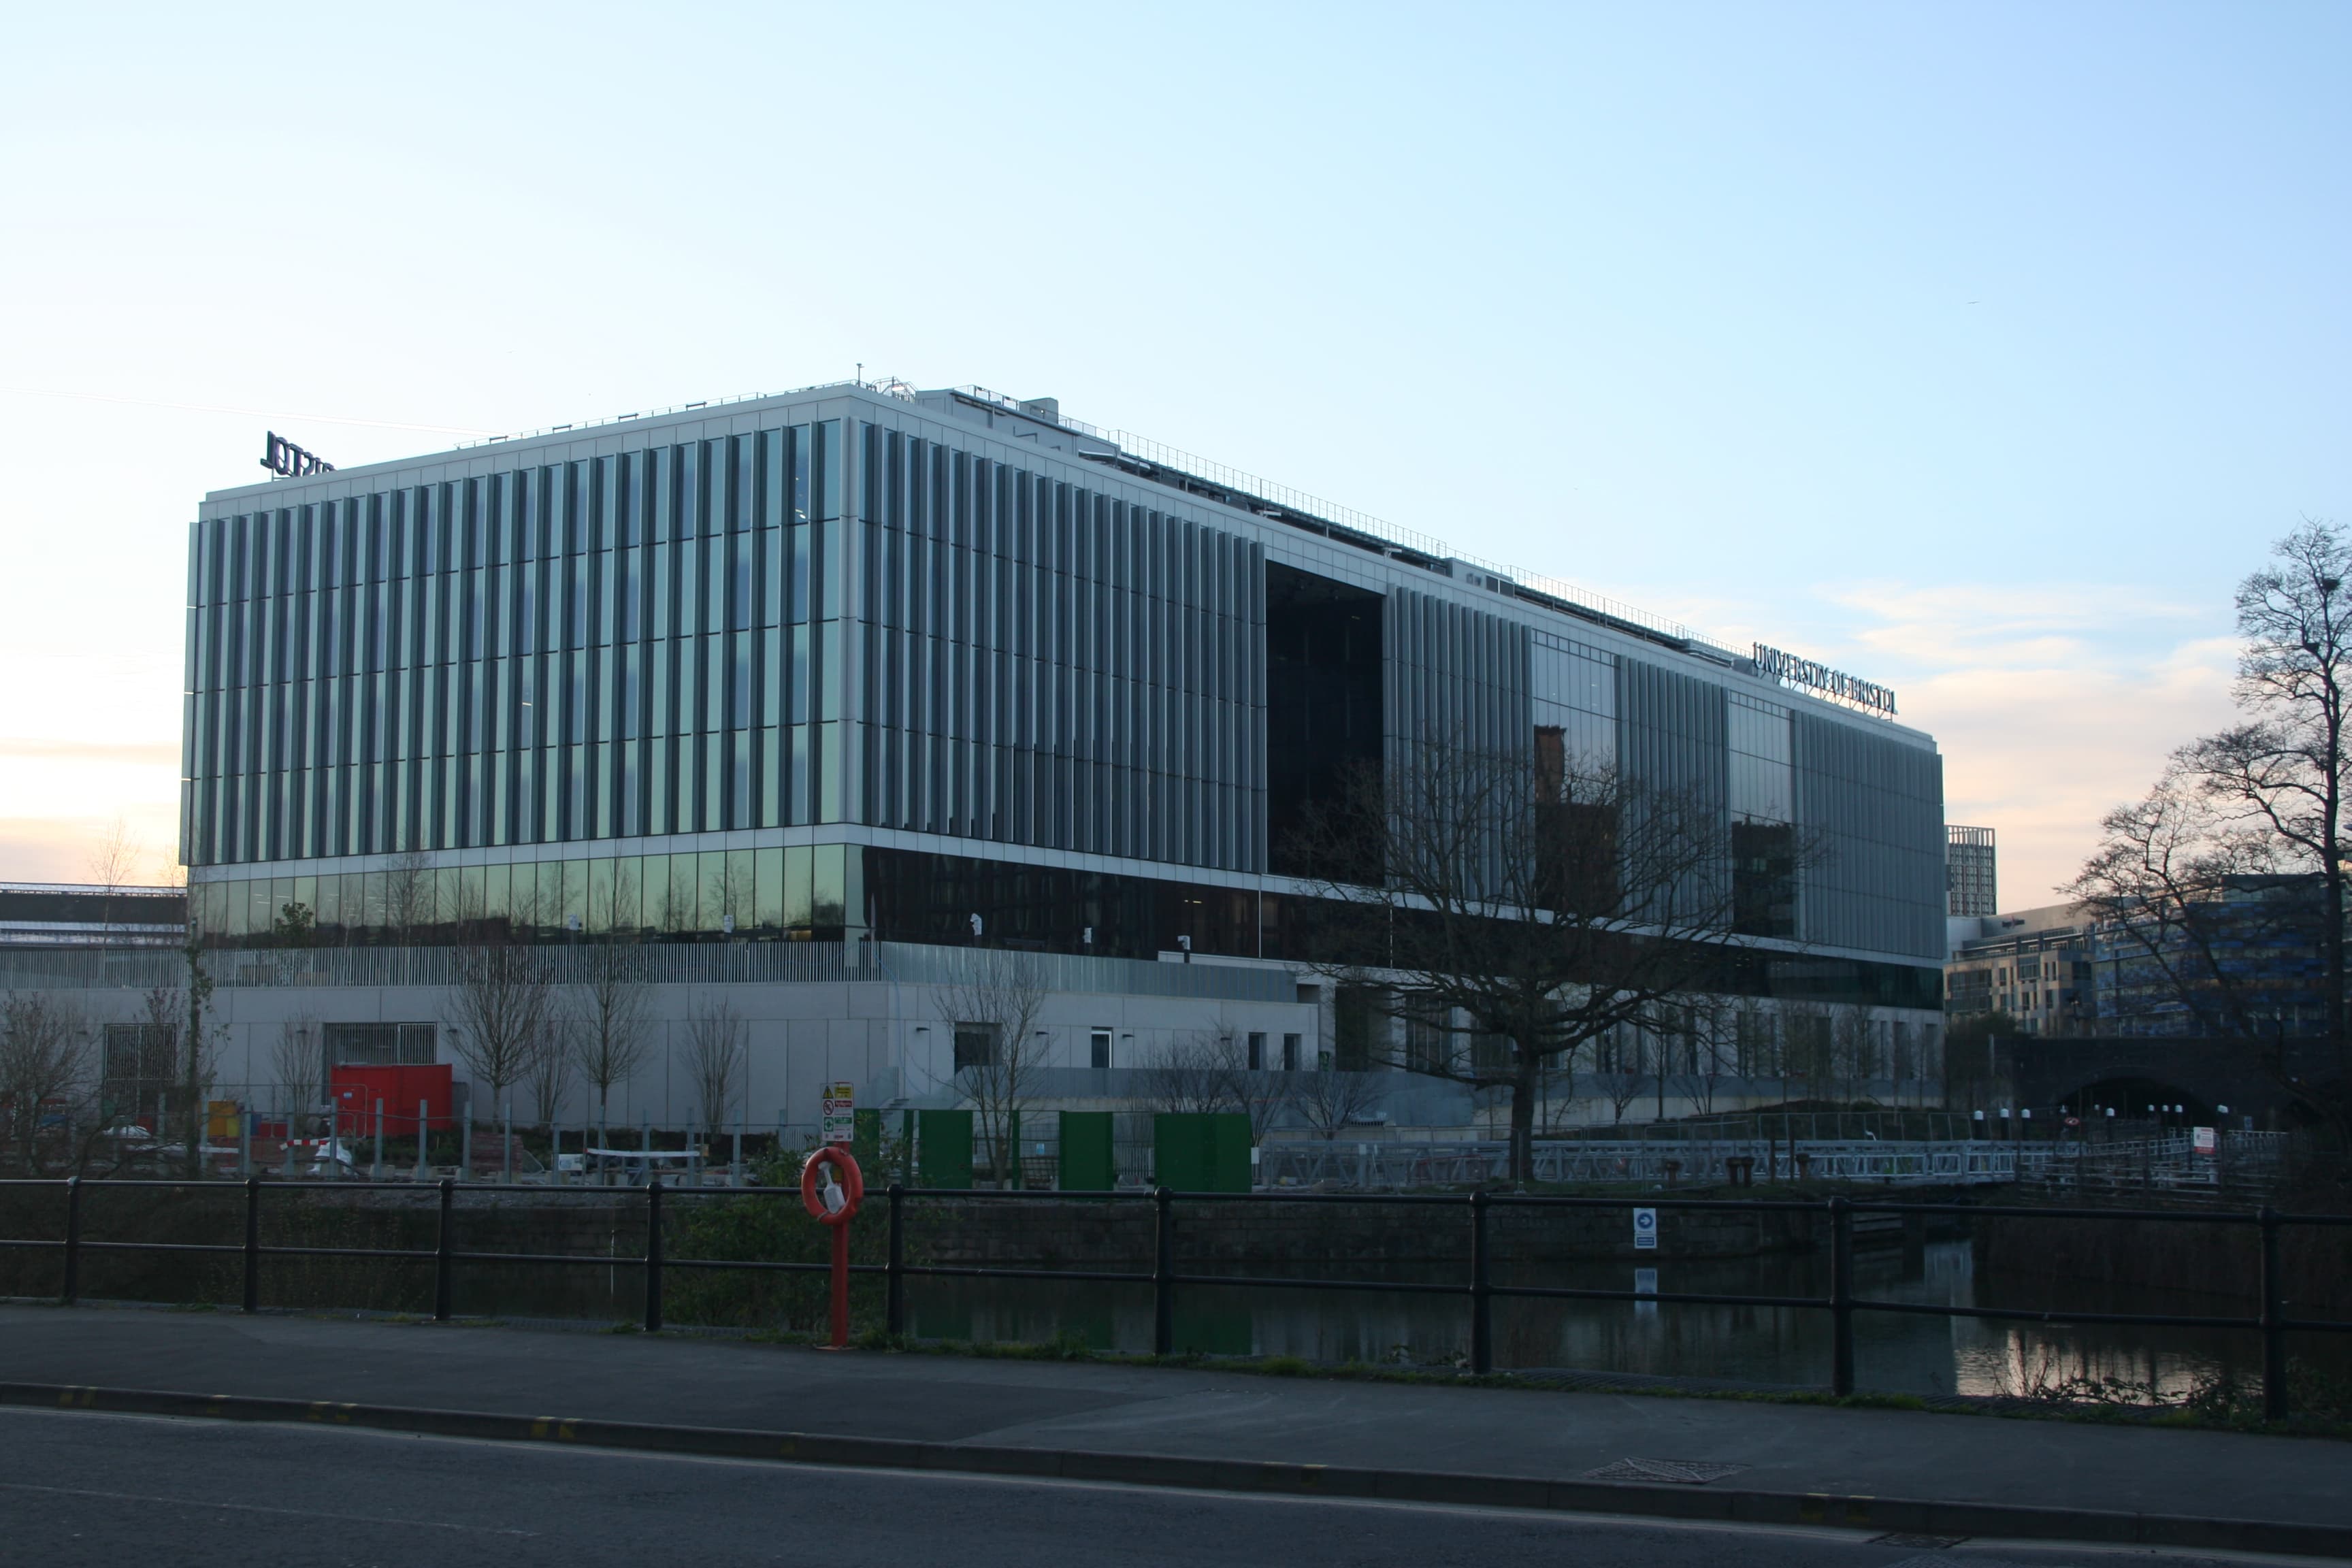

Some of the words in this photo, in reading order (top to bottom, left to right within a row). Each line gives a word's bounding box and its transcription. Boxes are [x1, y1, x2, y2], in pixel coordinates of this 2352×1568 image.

[1754, 642, 1829, 690] UNIVERSITY
[1832, 670, 1848, 695] OF
[1851, 676, 1898, 715] BRISTOL
